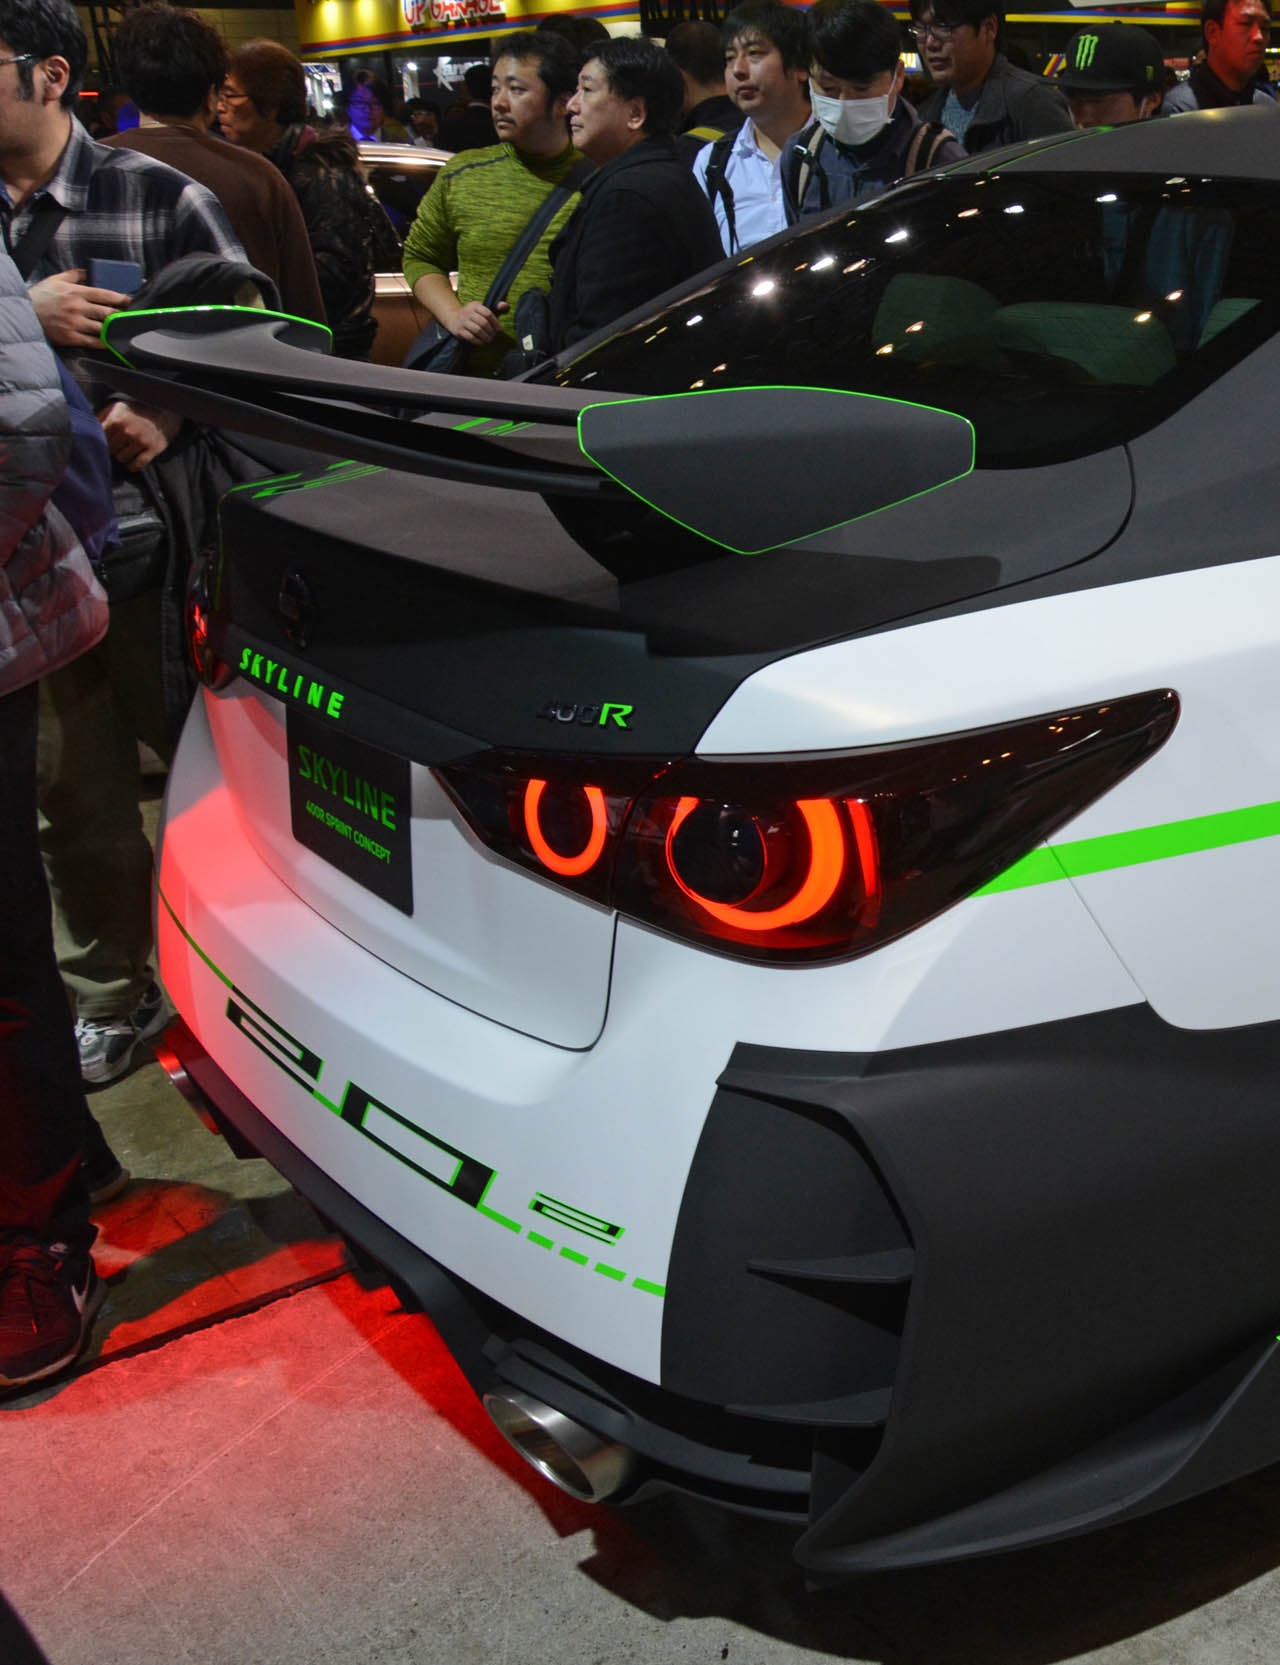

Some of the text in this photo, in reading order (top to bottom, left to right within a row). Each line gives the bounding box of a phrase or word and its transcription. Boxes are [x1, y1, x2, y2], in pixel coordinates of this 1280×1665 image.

[404, 0, 502, 24] UP GARAGE
[239, 648, 345, 720] SKYLINE
[297, 744, 397, 832] SKYLINE
[325, 811, 353, 841] SPRINT
[353, 829, 392, 865] CONCEPT
